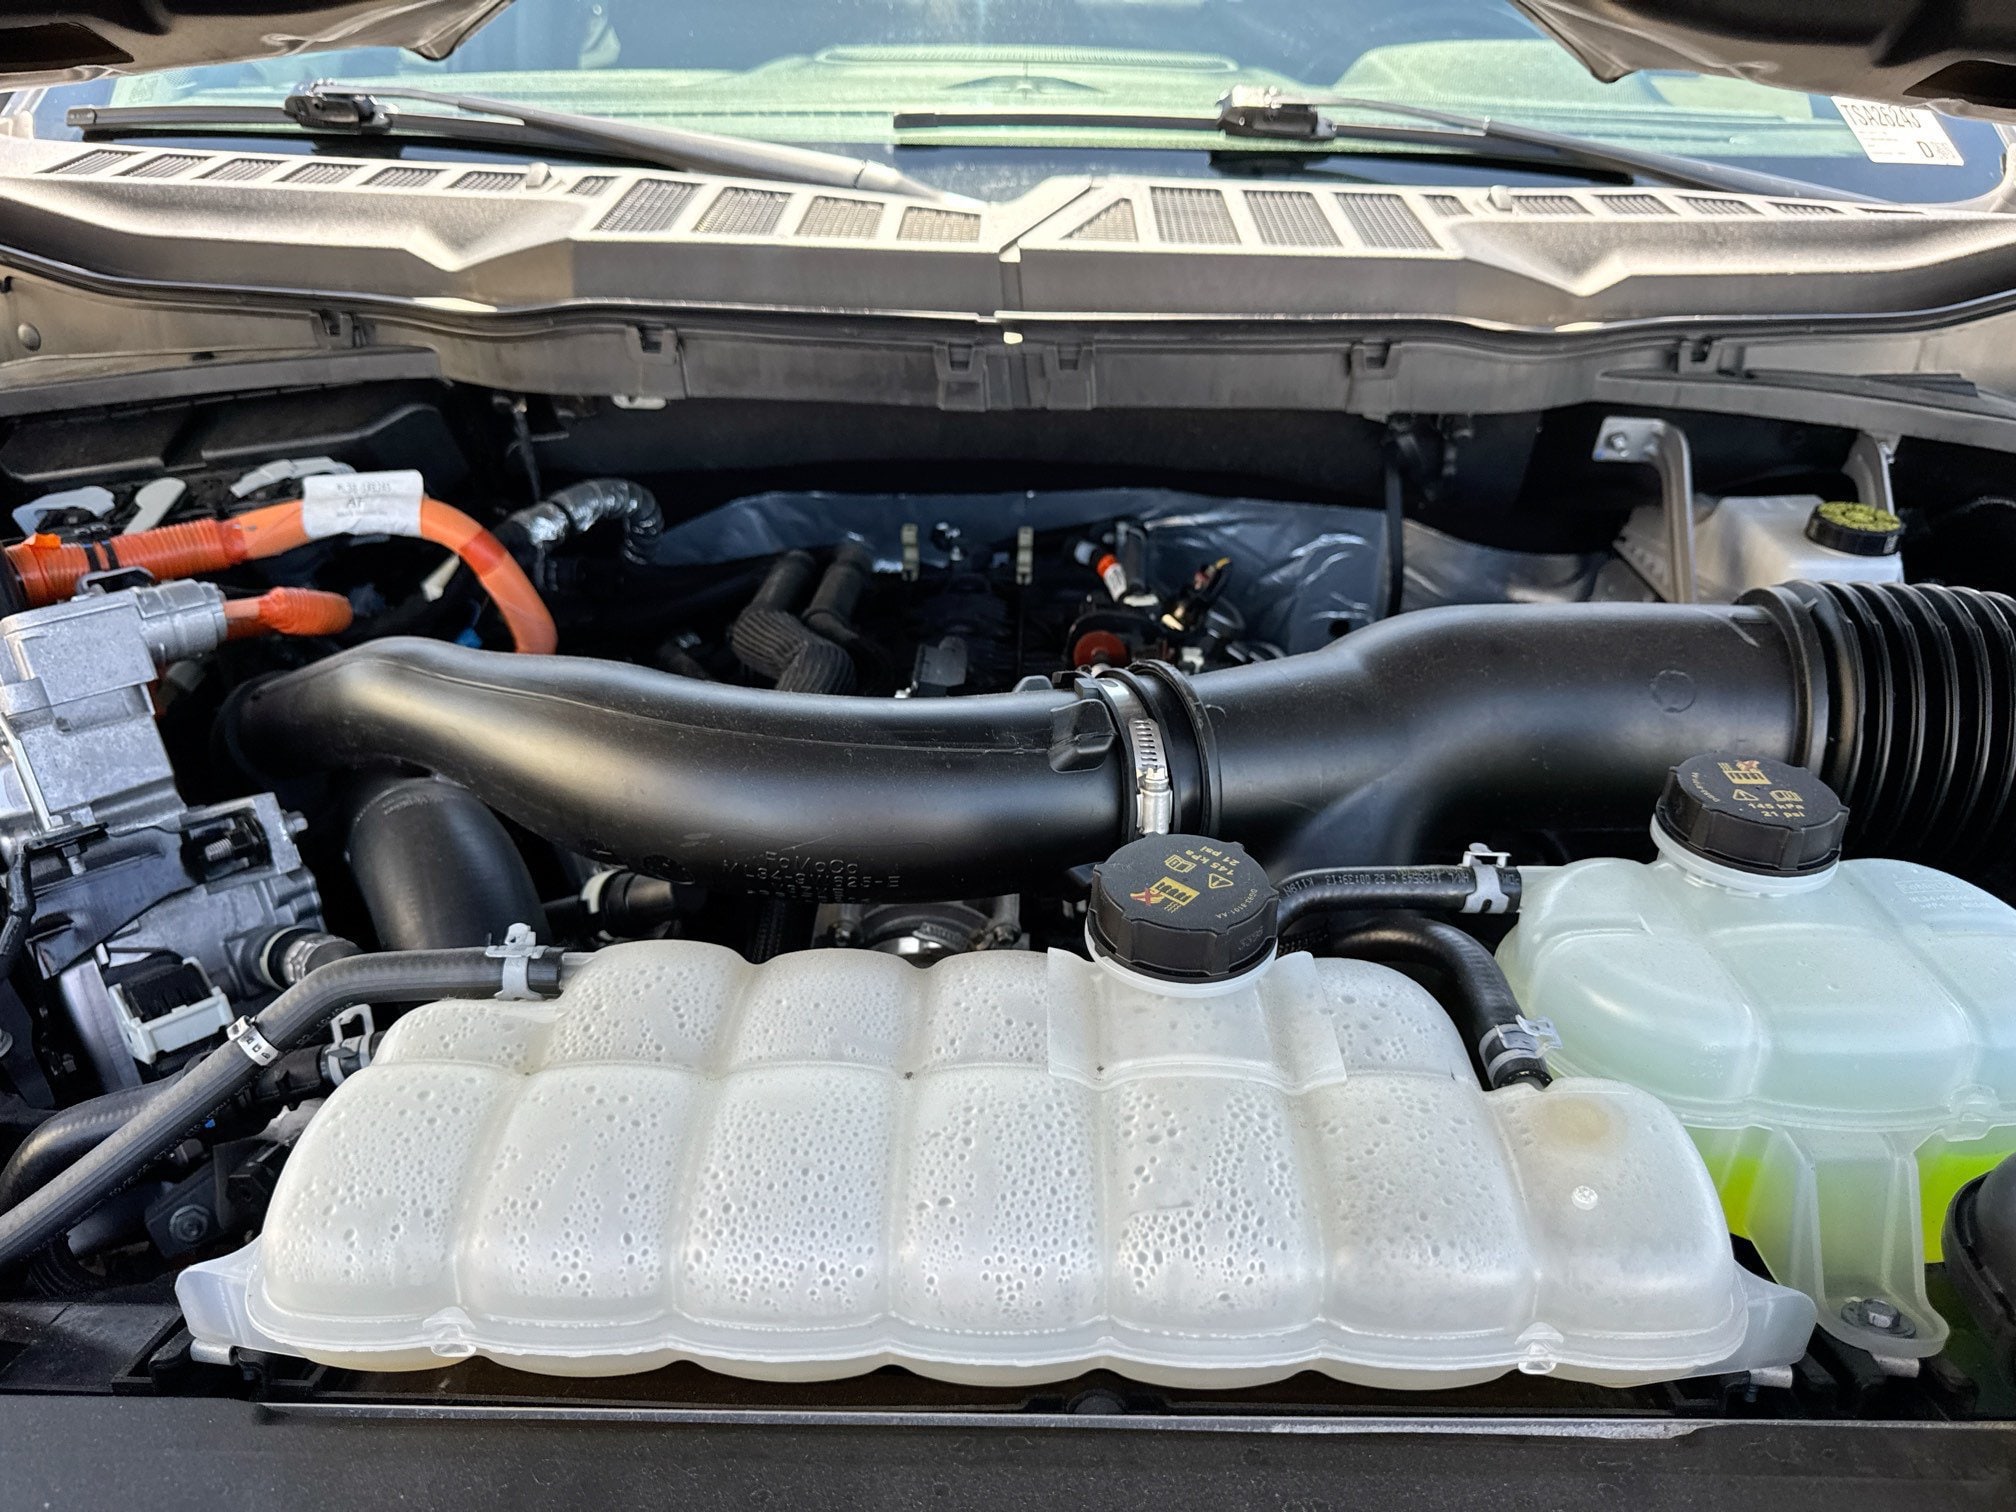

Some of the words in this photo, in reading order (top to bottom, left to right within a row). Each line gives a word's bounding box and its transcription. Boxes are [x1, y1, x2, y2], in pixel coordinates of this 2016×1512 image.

[1916, 140, 1935, 159] D
[1748, 802, 1775, 810] 145
[1761, 810, 1779, 818] 21
[1185, 849, 1210, 864] kPa
[1199, 845, 1223, 858] psi
[1222, 856, 1241, 867] 21
[1209, 862, 1235, 876] 145
